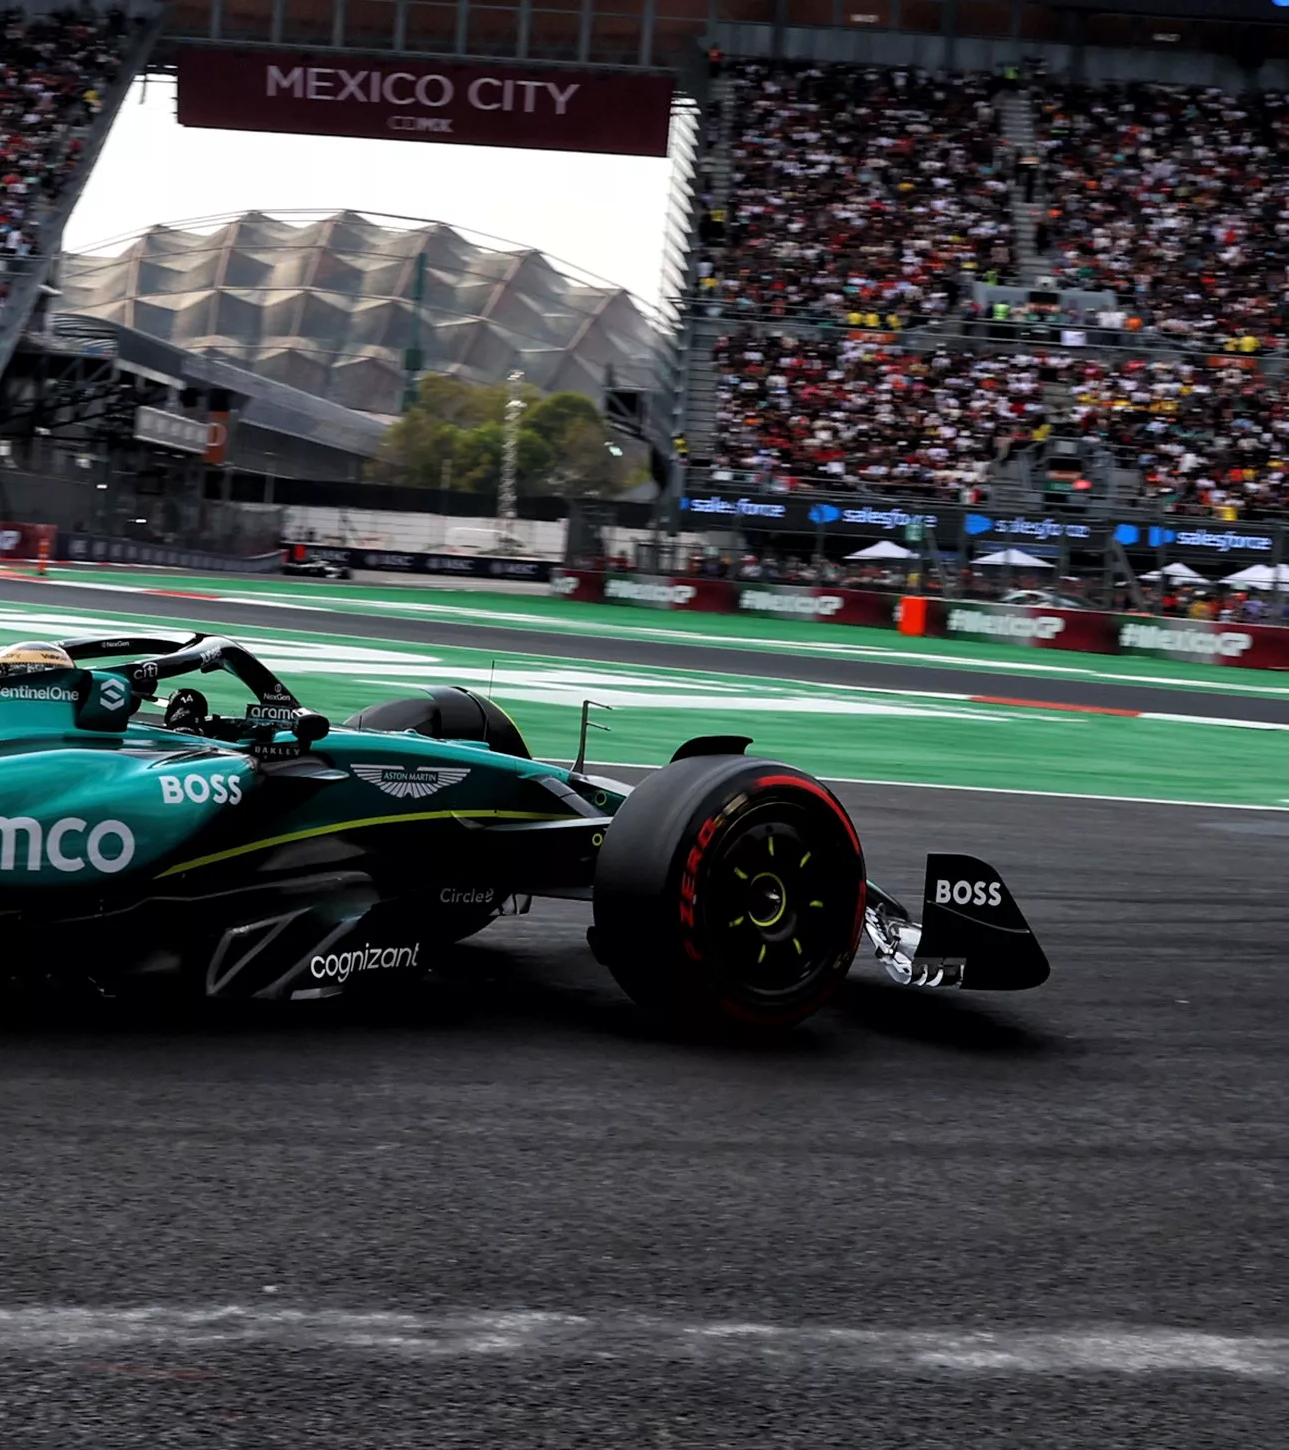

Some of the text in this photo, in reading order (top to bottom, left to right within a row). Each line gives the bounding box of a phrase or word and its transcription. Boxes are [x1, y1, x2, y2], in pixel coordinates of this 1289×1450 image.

[266, 65, 581, 115] MEXICO CITY
[994, 517, 1091, 539] salesfoce
[1176, 529, 1272, 552] salesforce
[133, 662, 159, 680] citi
[251, 706, 297, 721] aram
[383, 772, 437, 782] ASTON MARTIN
[159, 774, 242, 805] BOSS
[936, 879, 1002, 907] BOSS
[310, 942, 420, 983] cognizant
